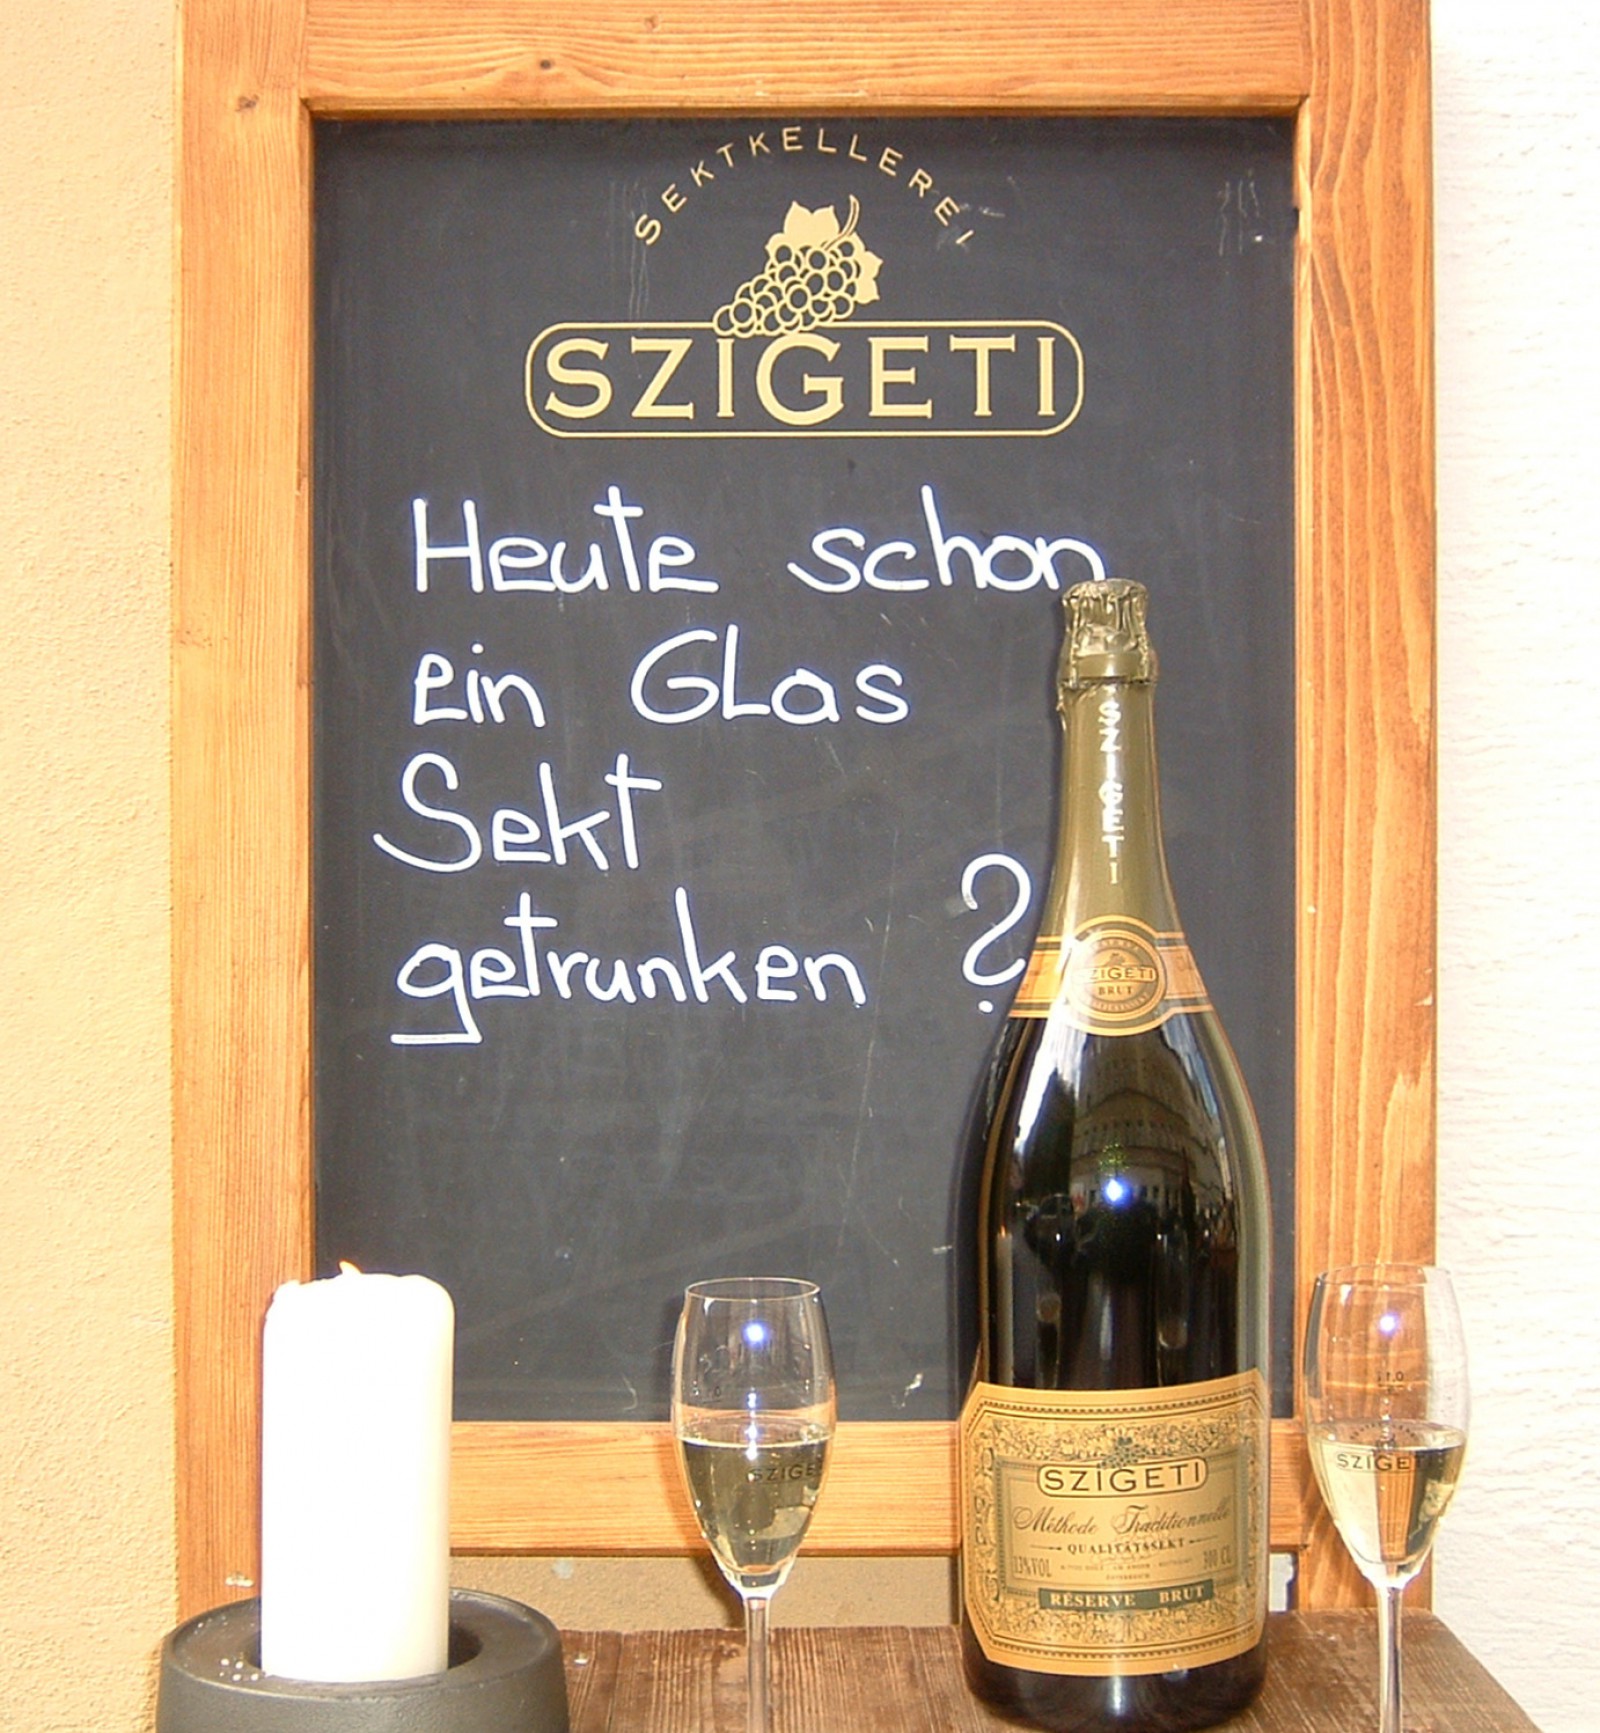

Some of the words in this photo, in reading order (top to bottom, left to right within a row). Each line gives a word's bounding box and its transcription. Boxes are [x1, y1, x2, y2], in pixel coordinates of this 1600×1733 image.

[635, 126, 973, 245] SEKTKELLEREI
[545, 331, 1055, 426] SZIGETI
[414, 486, 718, 593] Heute
[788, 486, 1105, 593] schon
[414, 644, 545, 727] ein
[374, 754, 661, 872] Sekt
[1098, 700, 1124, 884] SZIGETI
[391, 887, 866, 1044] getrunken
[962, 854, 1032, 1013] ?
[1083, 967, 1153, 980] ZIGETI
[1098, 985, 1133, 996] BRUT
[746, 1463, 818, 1482] SZIGE
[1045, 1462, 1199, 1492] SZIGETI
[1337, 1453, 1414, 1472] SZIGE
[1159, 1585, 1205, 1604] BRUT
